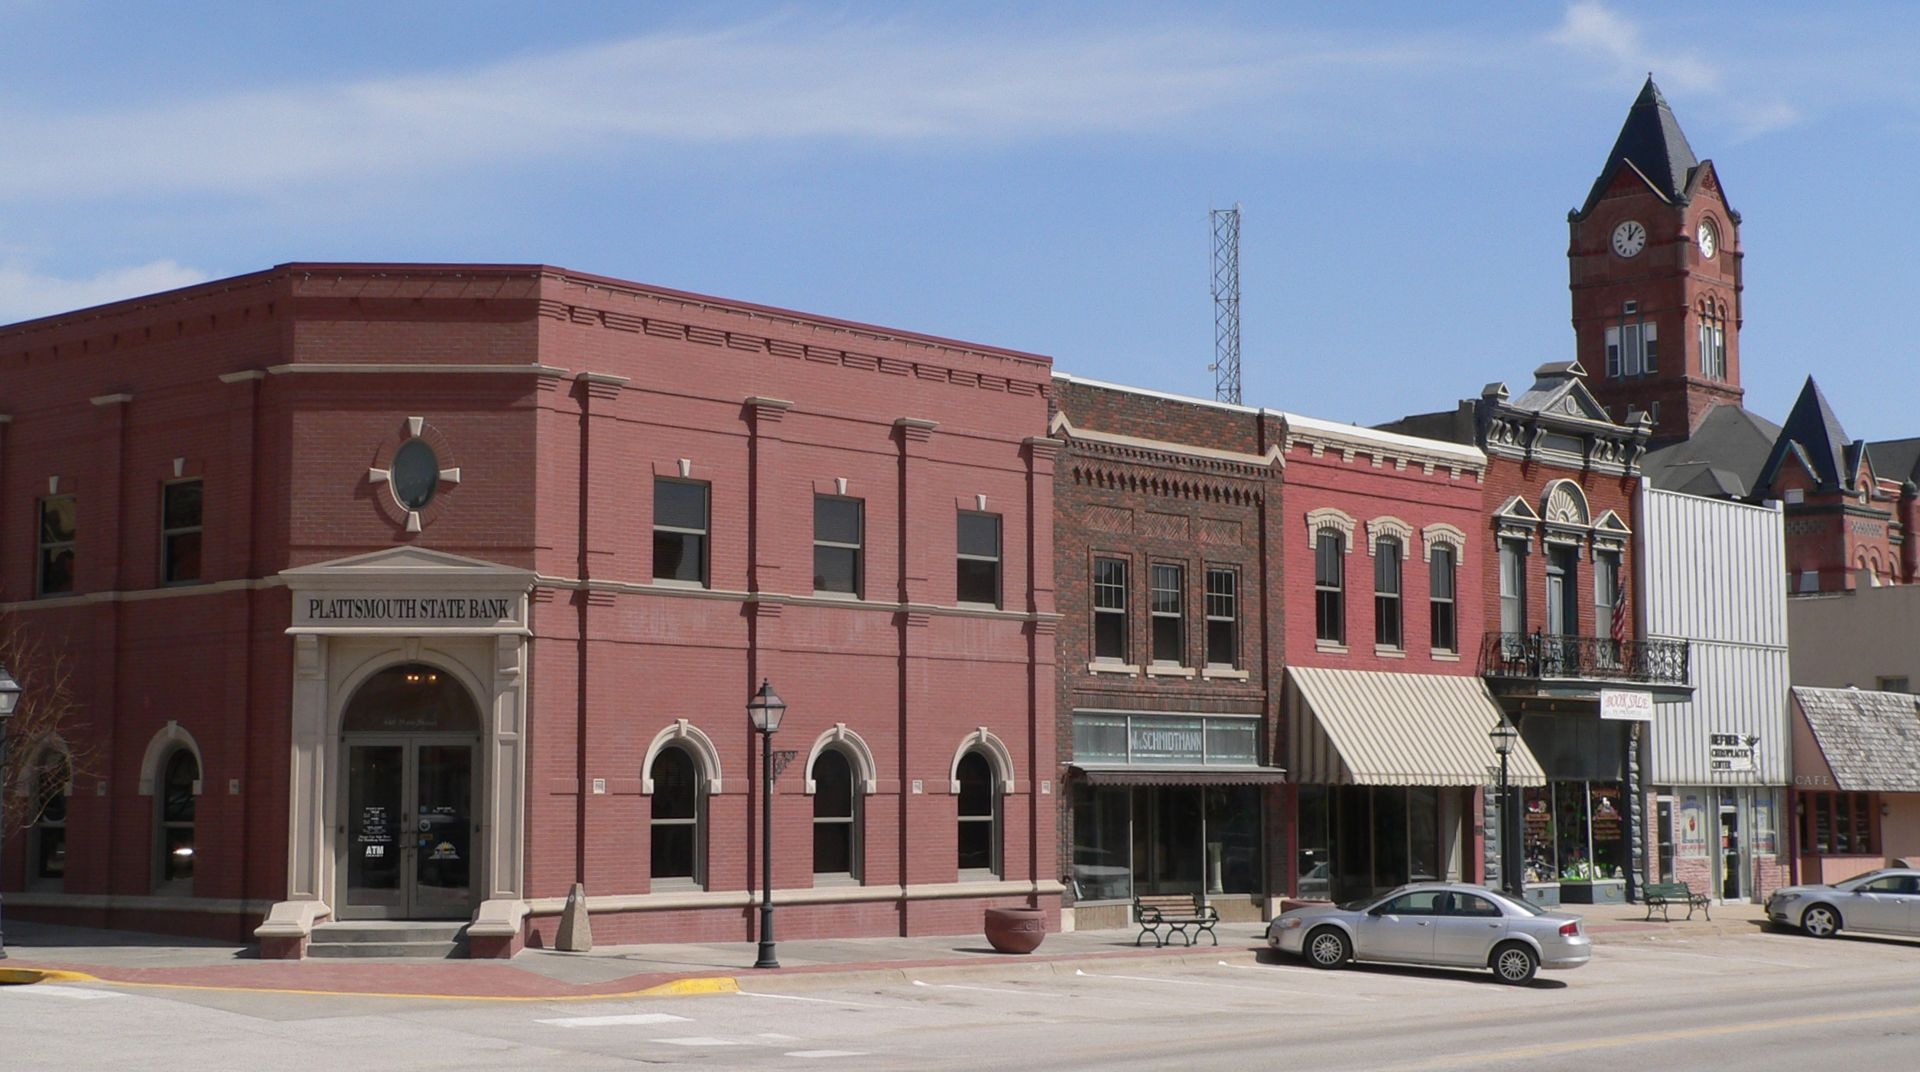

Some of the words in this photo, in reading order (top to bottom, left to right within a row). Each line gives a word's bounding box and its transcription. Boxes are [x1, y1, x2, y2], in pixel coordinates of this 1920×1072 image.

[309, 599, 417, 619] PLATTSMOUTH
[420, 599, 466, 619] STATE
[469, 599, 509, 619] BANK
[1628, 694, 1649, 709] SALE
[1142, 731, 1202, 751] SCHMIDTMANN
[1794, 775, 1829, 786] CAFE
[366, 845, 384, 855] ATM
